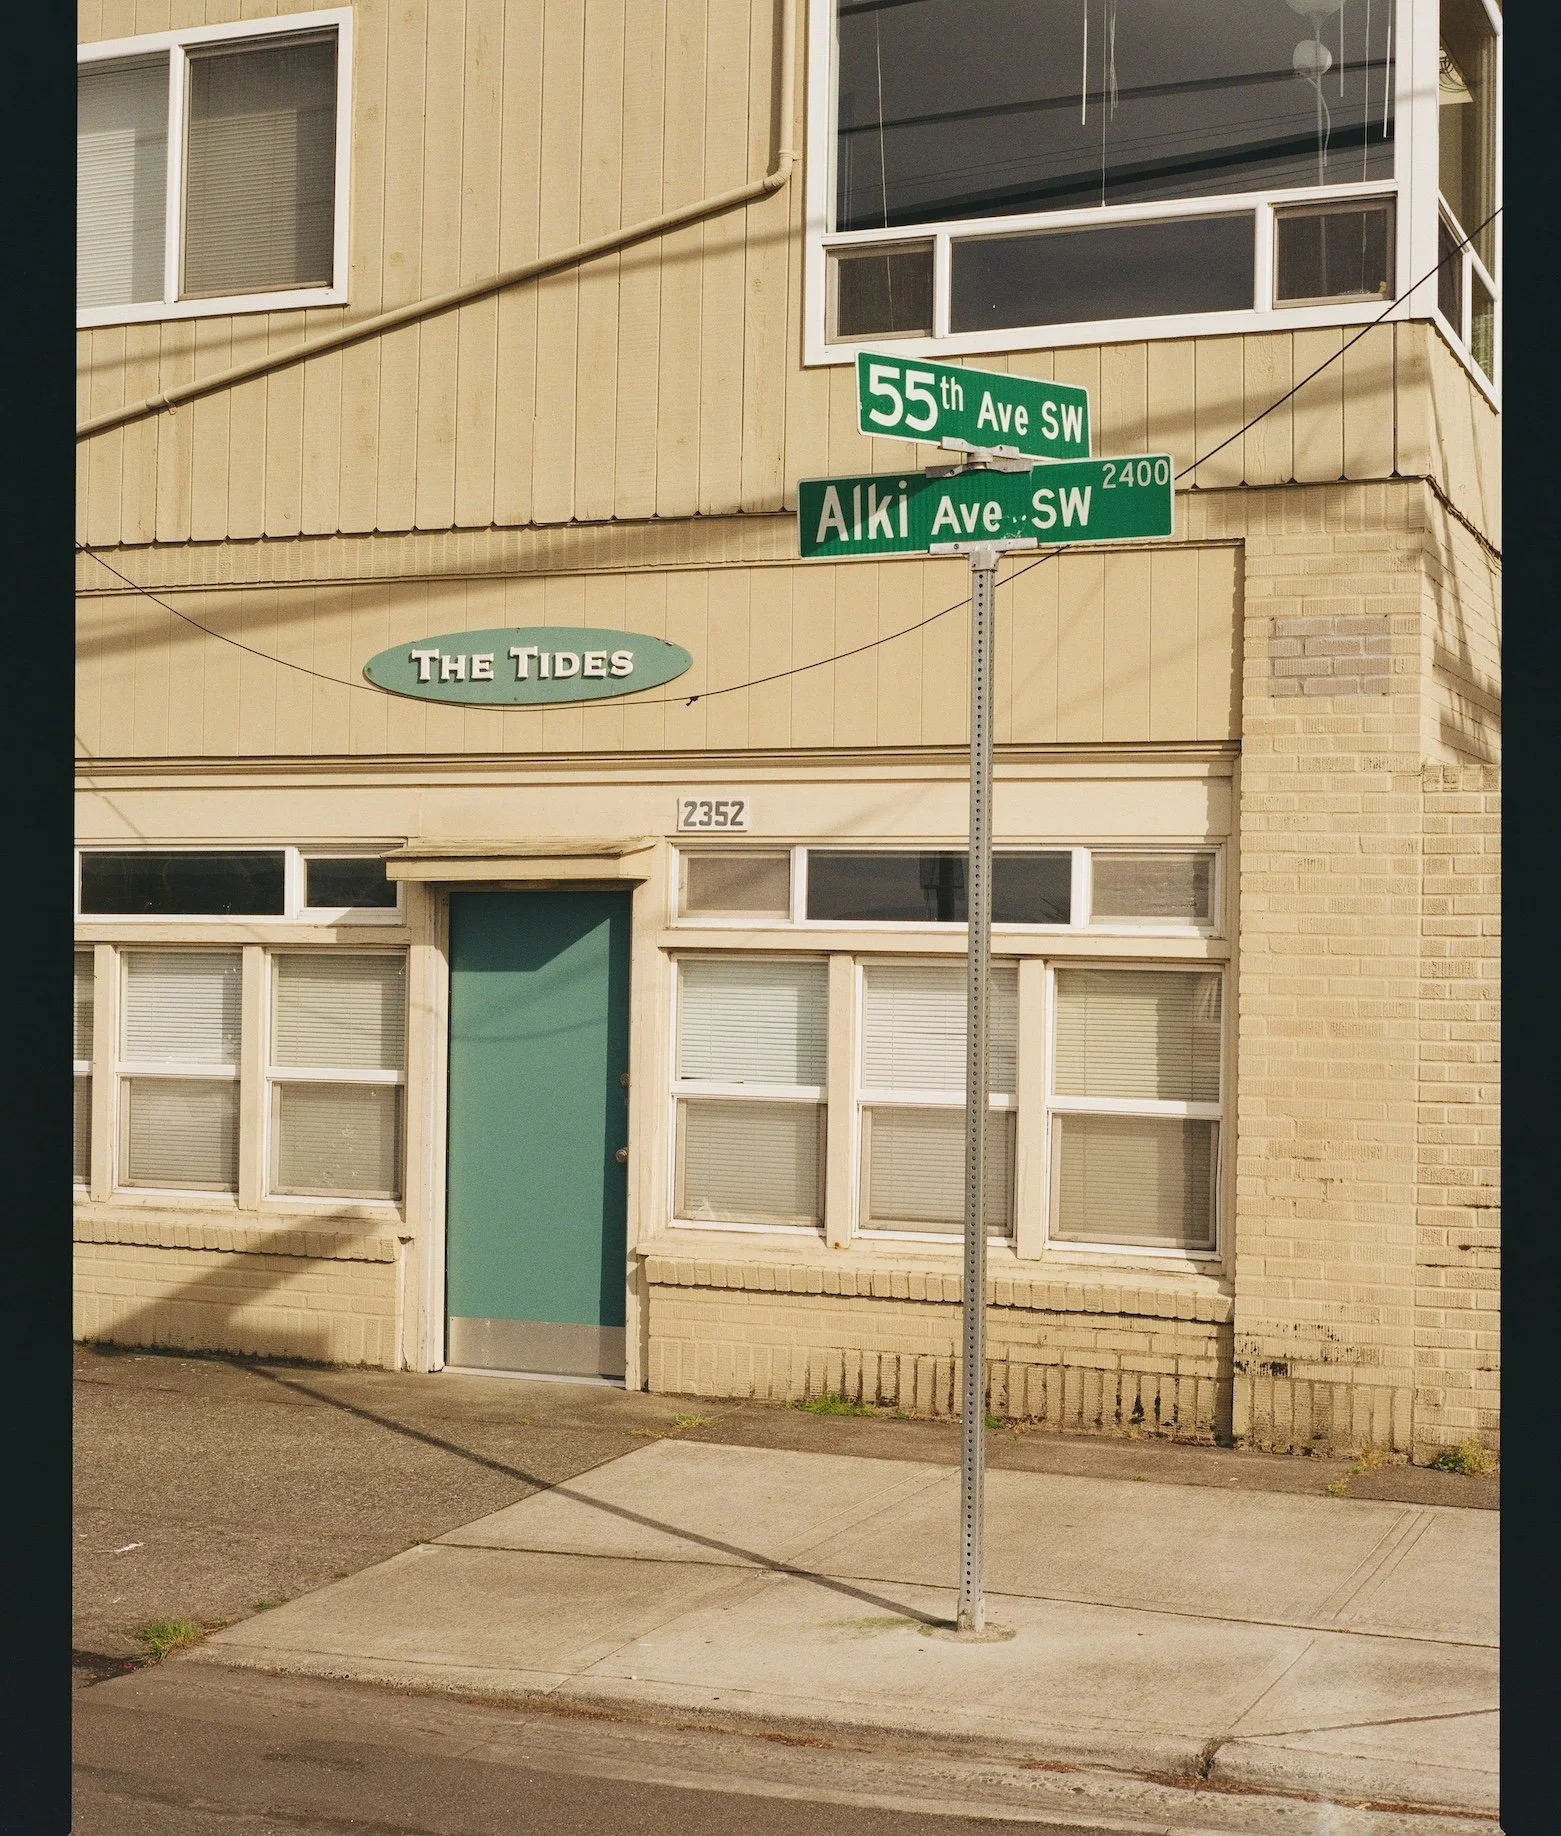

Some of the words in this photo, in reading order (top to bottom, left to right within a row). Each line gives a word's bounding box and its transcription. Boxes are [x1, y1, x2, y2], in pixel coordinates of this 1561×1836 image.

[868, 363, 964, 432] 55th
[976, 390, 1028, 436] Ave
[1041, 400, 1083, 443] SW
[1101, 459, 1170, 489] 2400
[815, 480, 909, 543] Alki
[930, 495, 1003, 535] Ave
[1031, 486, 1092, 530] SW
[411, 648, 495, 681] THE
[509, 645, 634, 679] TIDES
[683, 800, 745, 827] 2352
